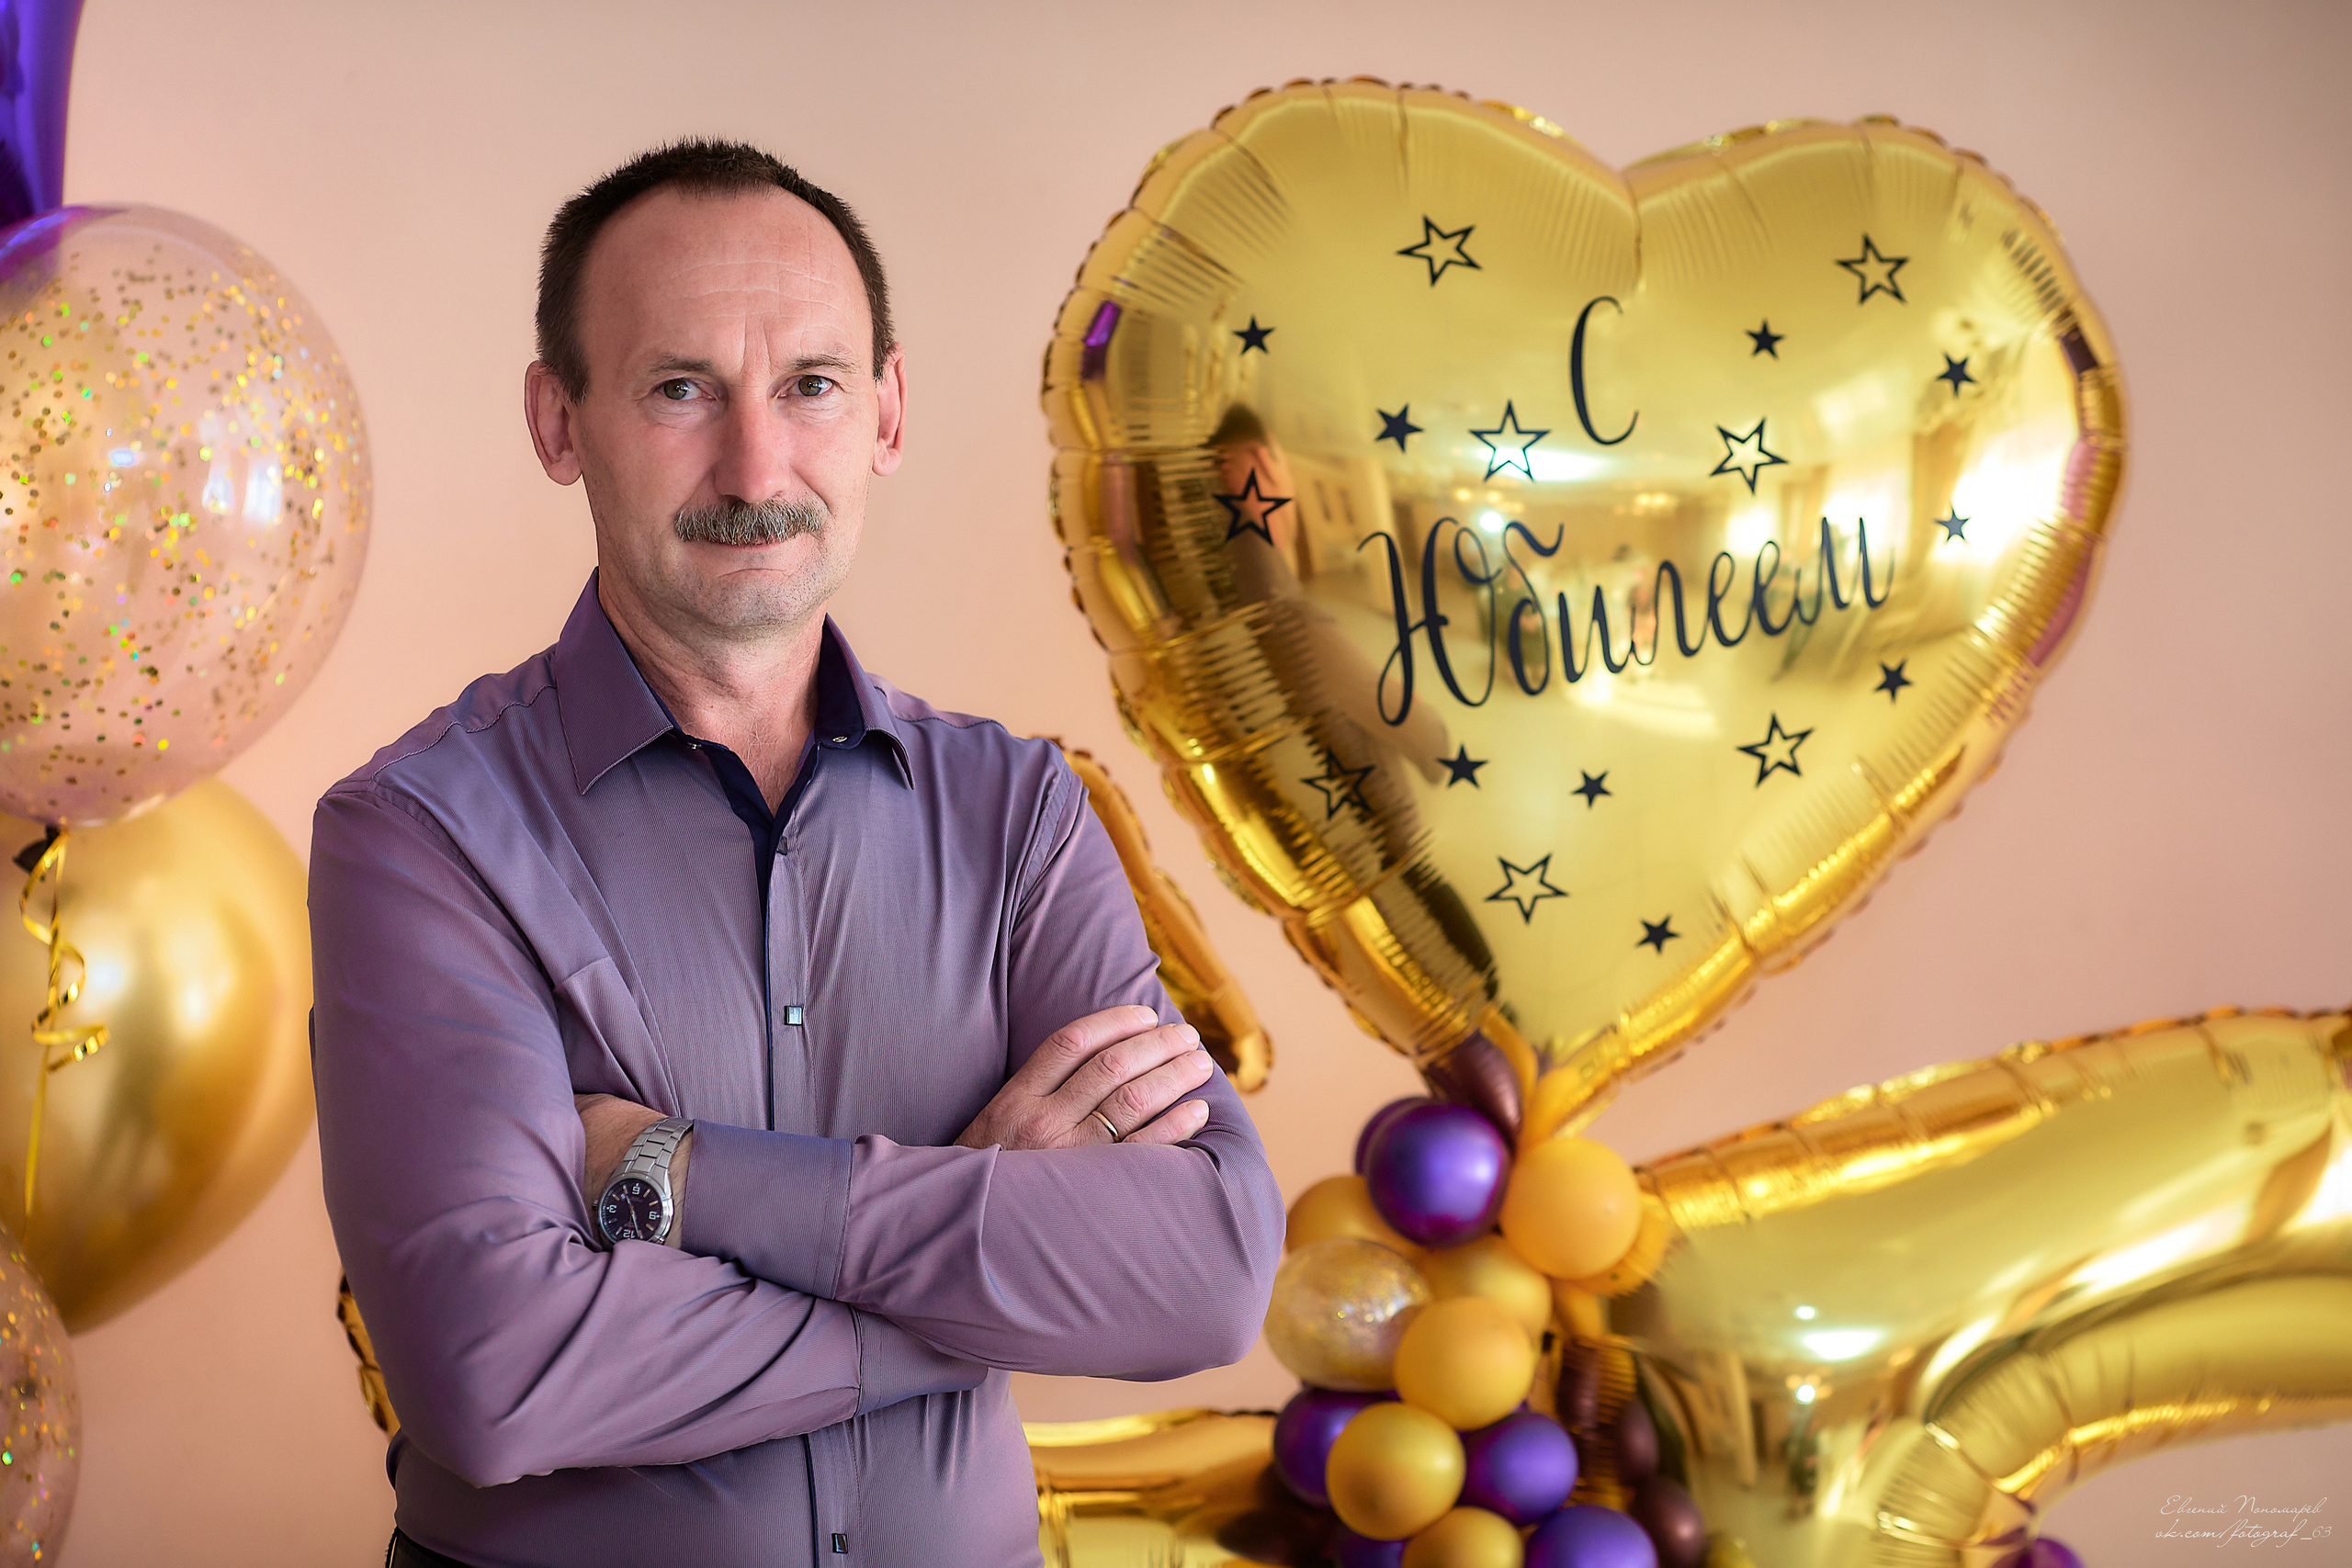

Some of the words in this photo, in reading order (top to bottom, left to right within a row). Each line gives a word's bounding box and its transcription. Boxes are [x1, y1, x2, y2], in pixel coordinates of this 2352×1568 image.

[1570, 295, 1639, 446] С
[1356, 516, 1895, 727] Юбилеем
[632, 1186, 640, 1195] 6
[608, 1204, 616, 1213] 3
[649, 1211, 658, 1220] 9
[623, 1229, 635, 1238] 12
